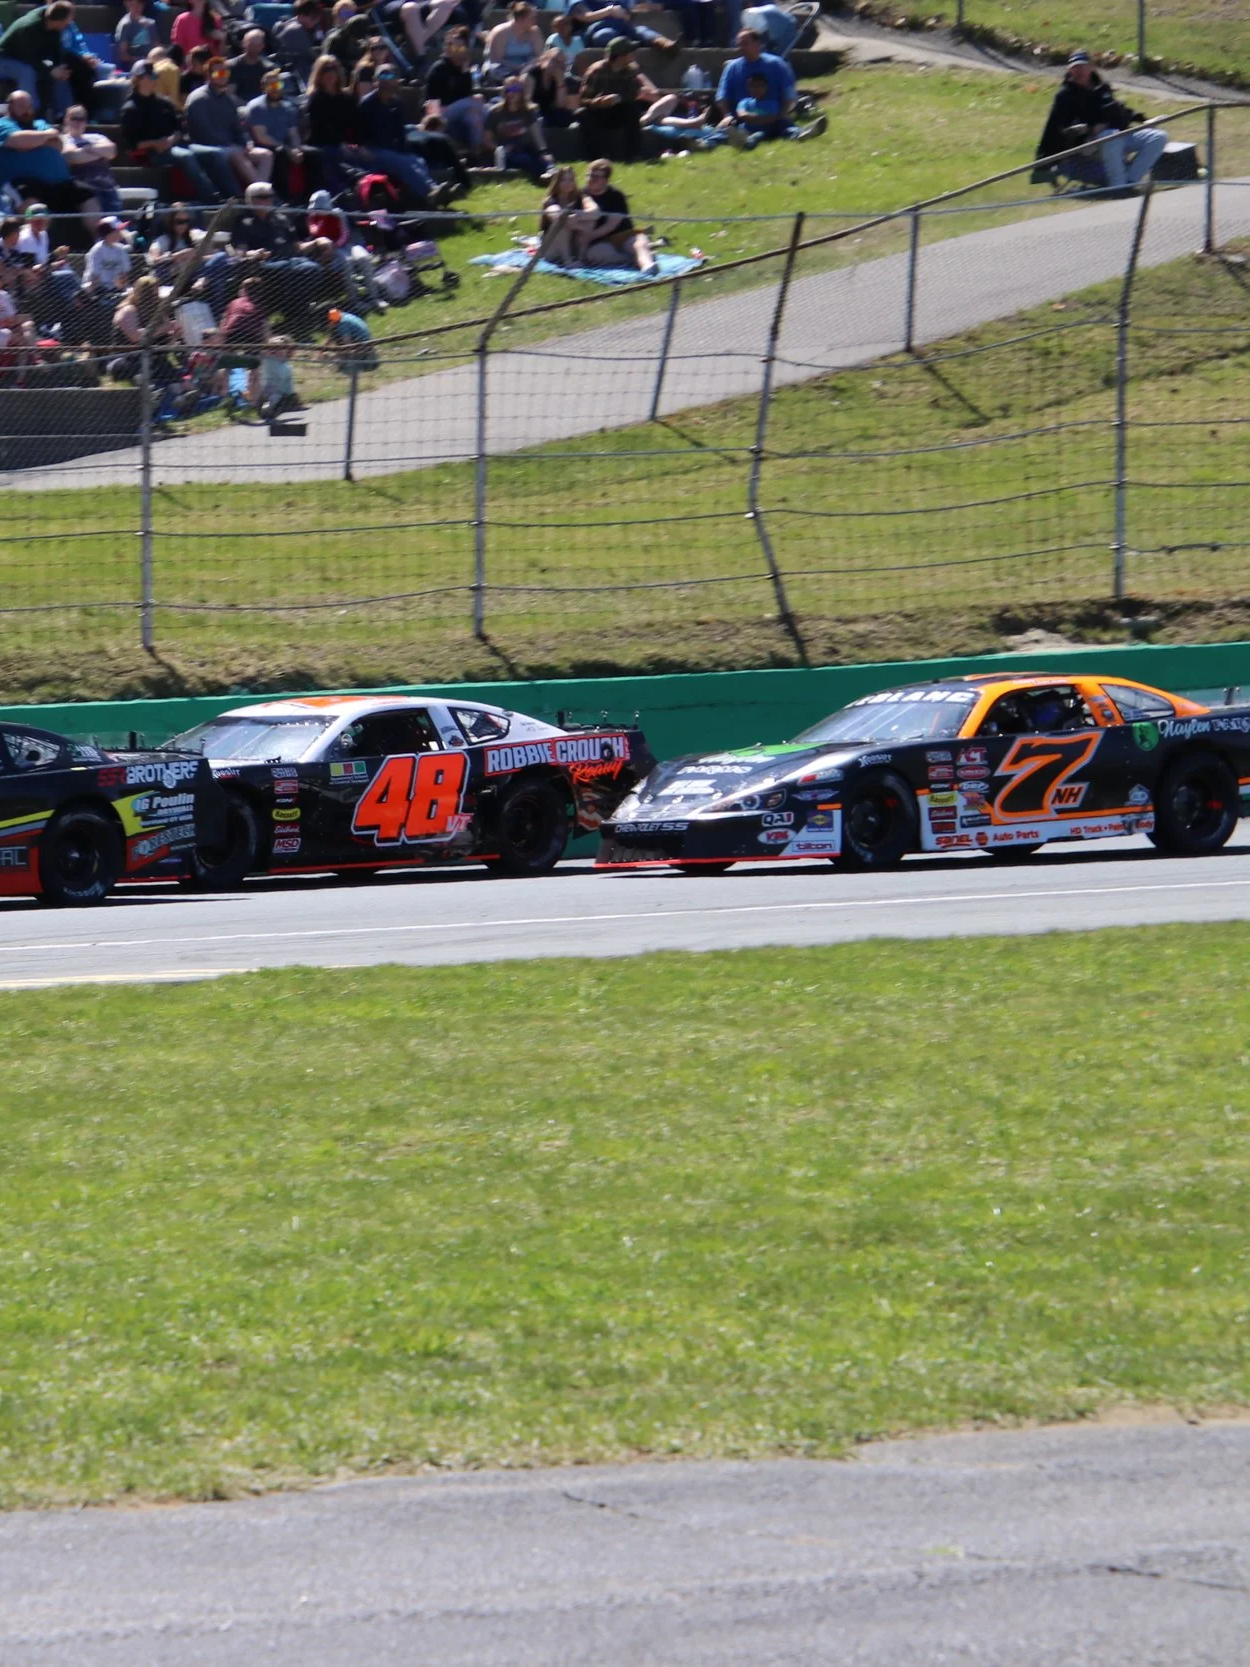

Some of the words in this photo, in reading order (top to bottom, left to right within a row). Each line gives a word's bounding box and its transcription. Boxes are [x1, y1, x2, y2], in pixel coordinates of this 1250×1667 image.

[487, 742, 556, 773] ROBBIE
[994, 730, 1105, 822] 7
[352, 751, 469, 846] 48
[1051, 787, 1083, 804] NH
[445, 814, 472, 832] VT
[660, 822, 690, 831] SS
[763, 812, 793, 825] QA1
[276, 840, 298, 848] MSD
[993, 832, 1014, 842] Auto
[1015, 830, 1039, 839] Parts
